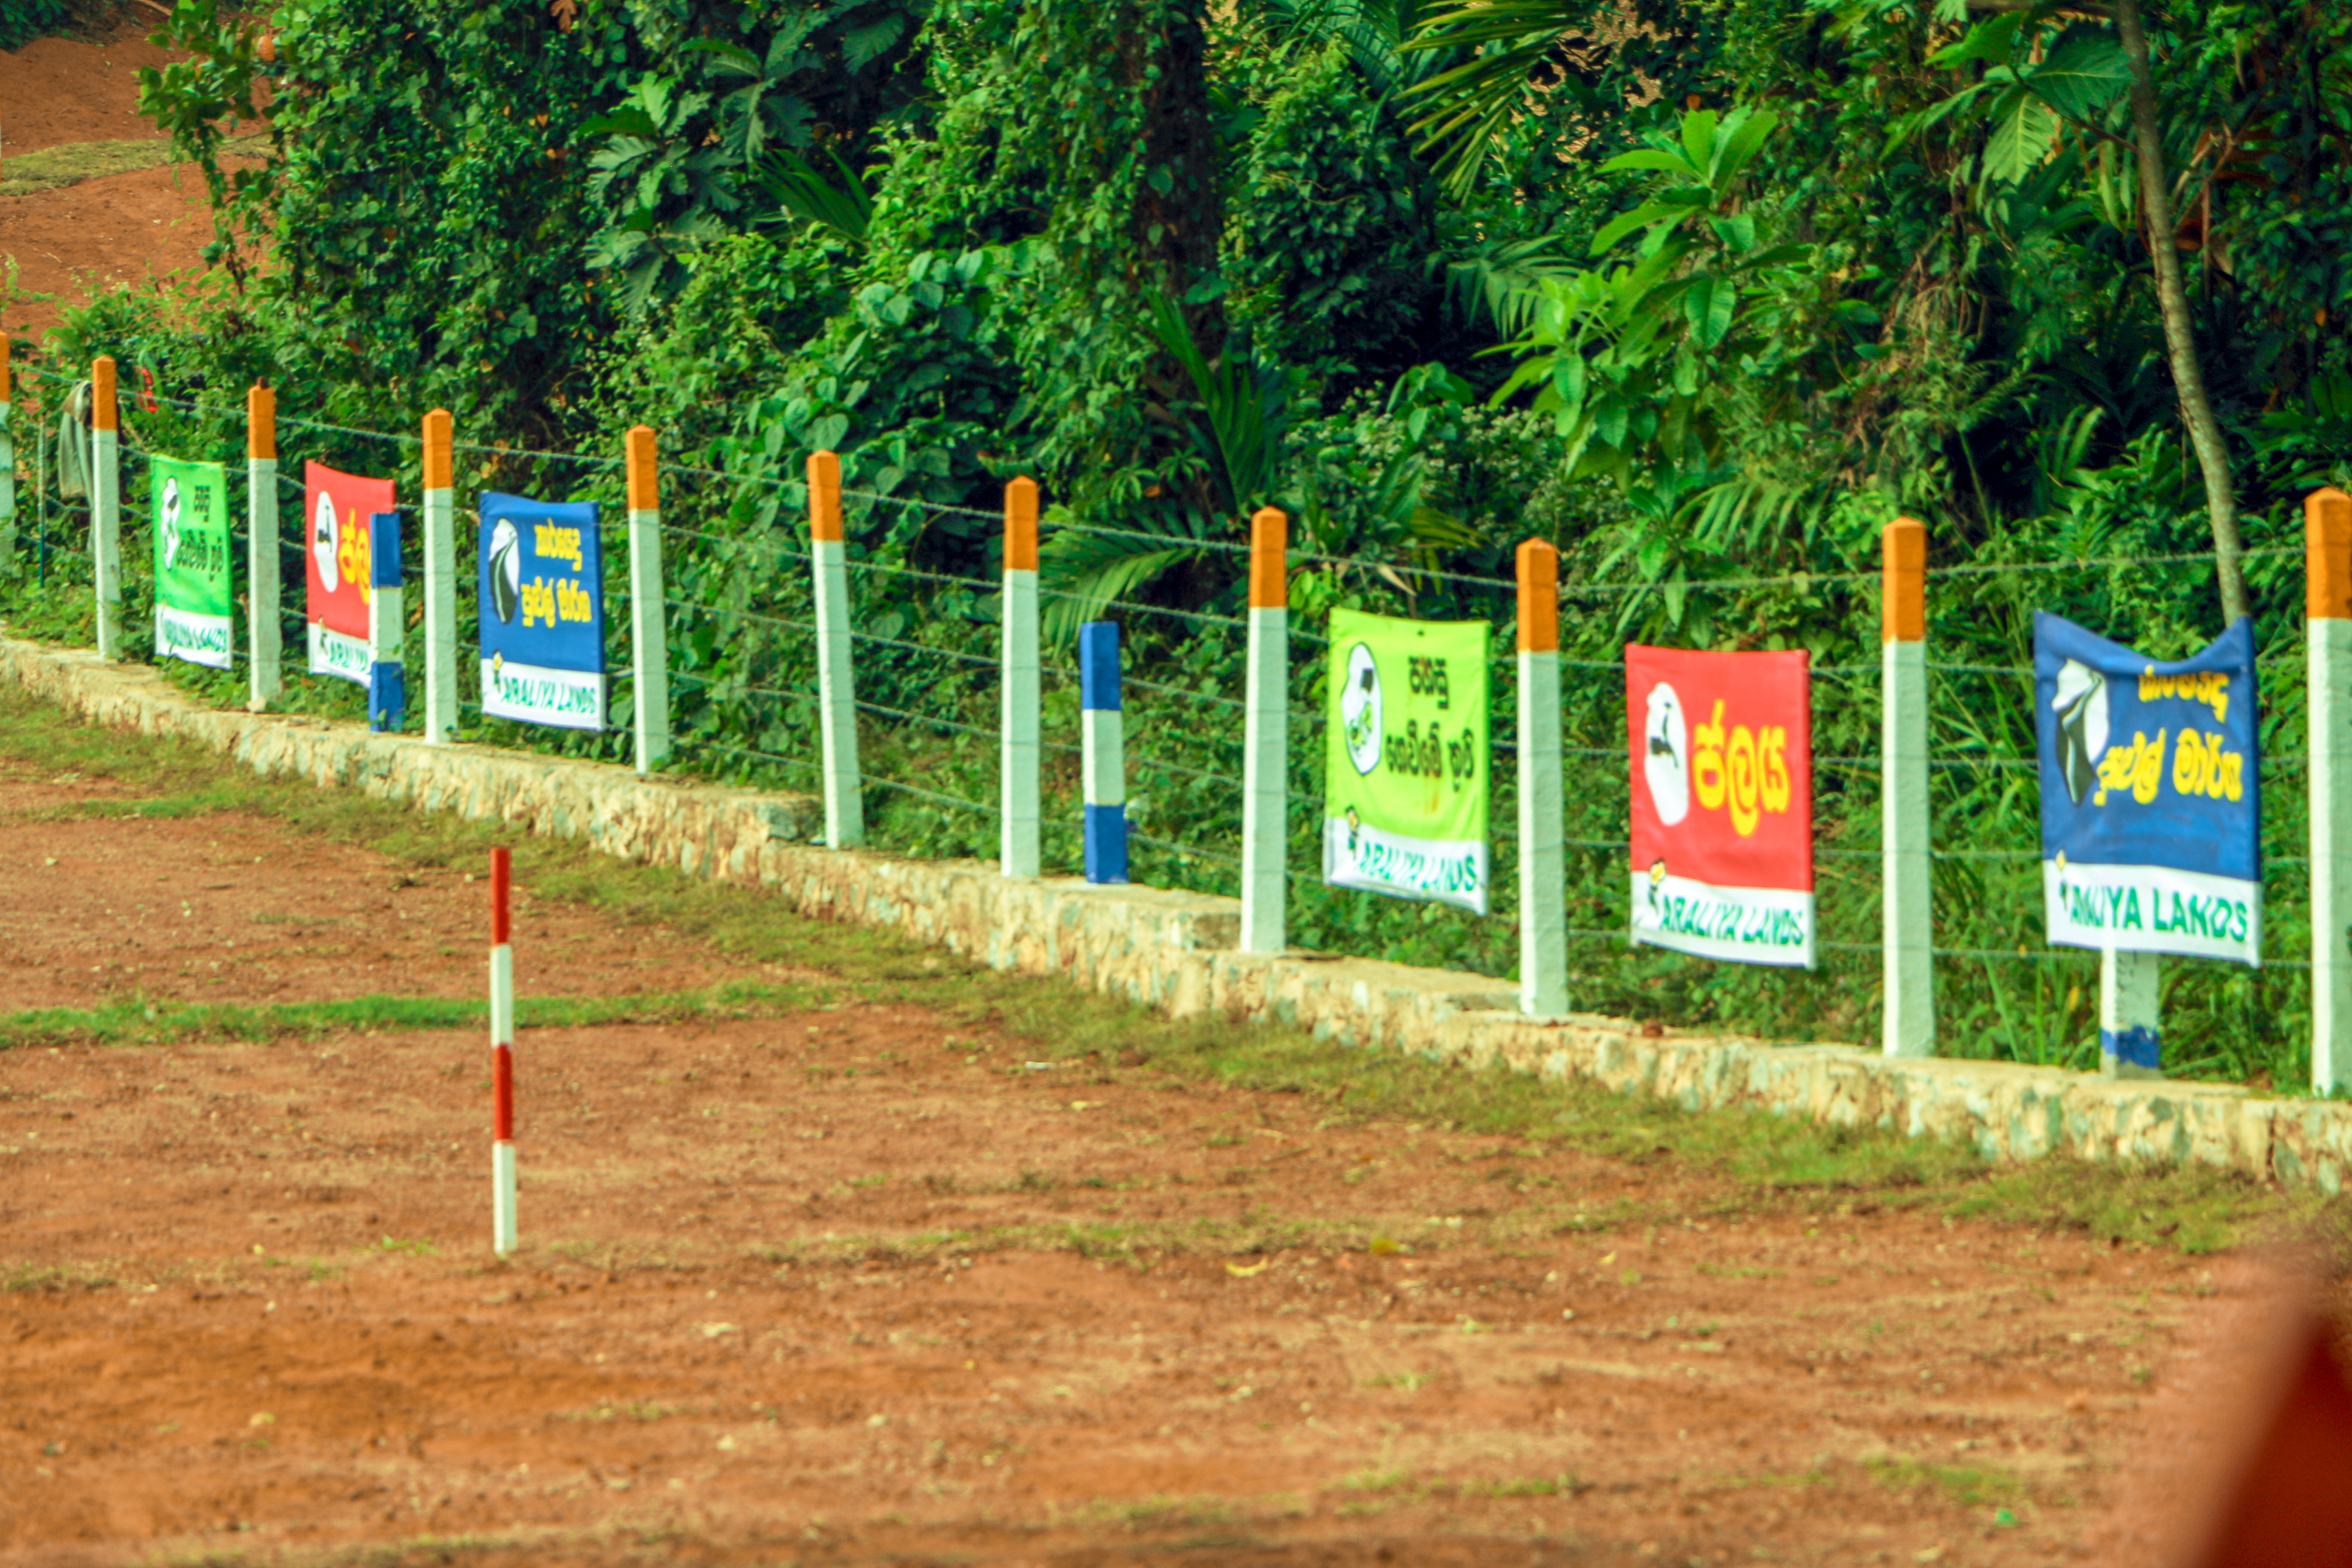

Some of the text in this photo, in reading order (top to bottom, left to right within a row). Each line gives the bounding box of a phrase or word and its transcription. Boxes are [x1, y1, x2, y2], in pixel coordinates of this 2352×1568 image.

[339, 507, 370, 605] ජල
[501, 677, 597, 714] ARALIYA LANDS
[1693, 698, 1791, 838] ජලය
[1421, 854, 1476, 891] LANDS
[1658, 894, 1804, 945] ARALIYA LANDS
[2153, 887, 2248, 942] LANDS
